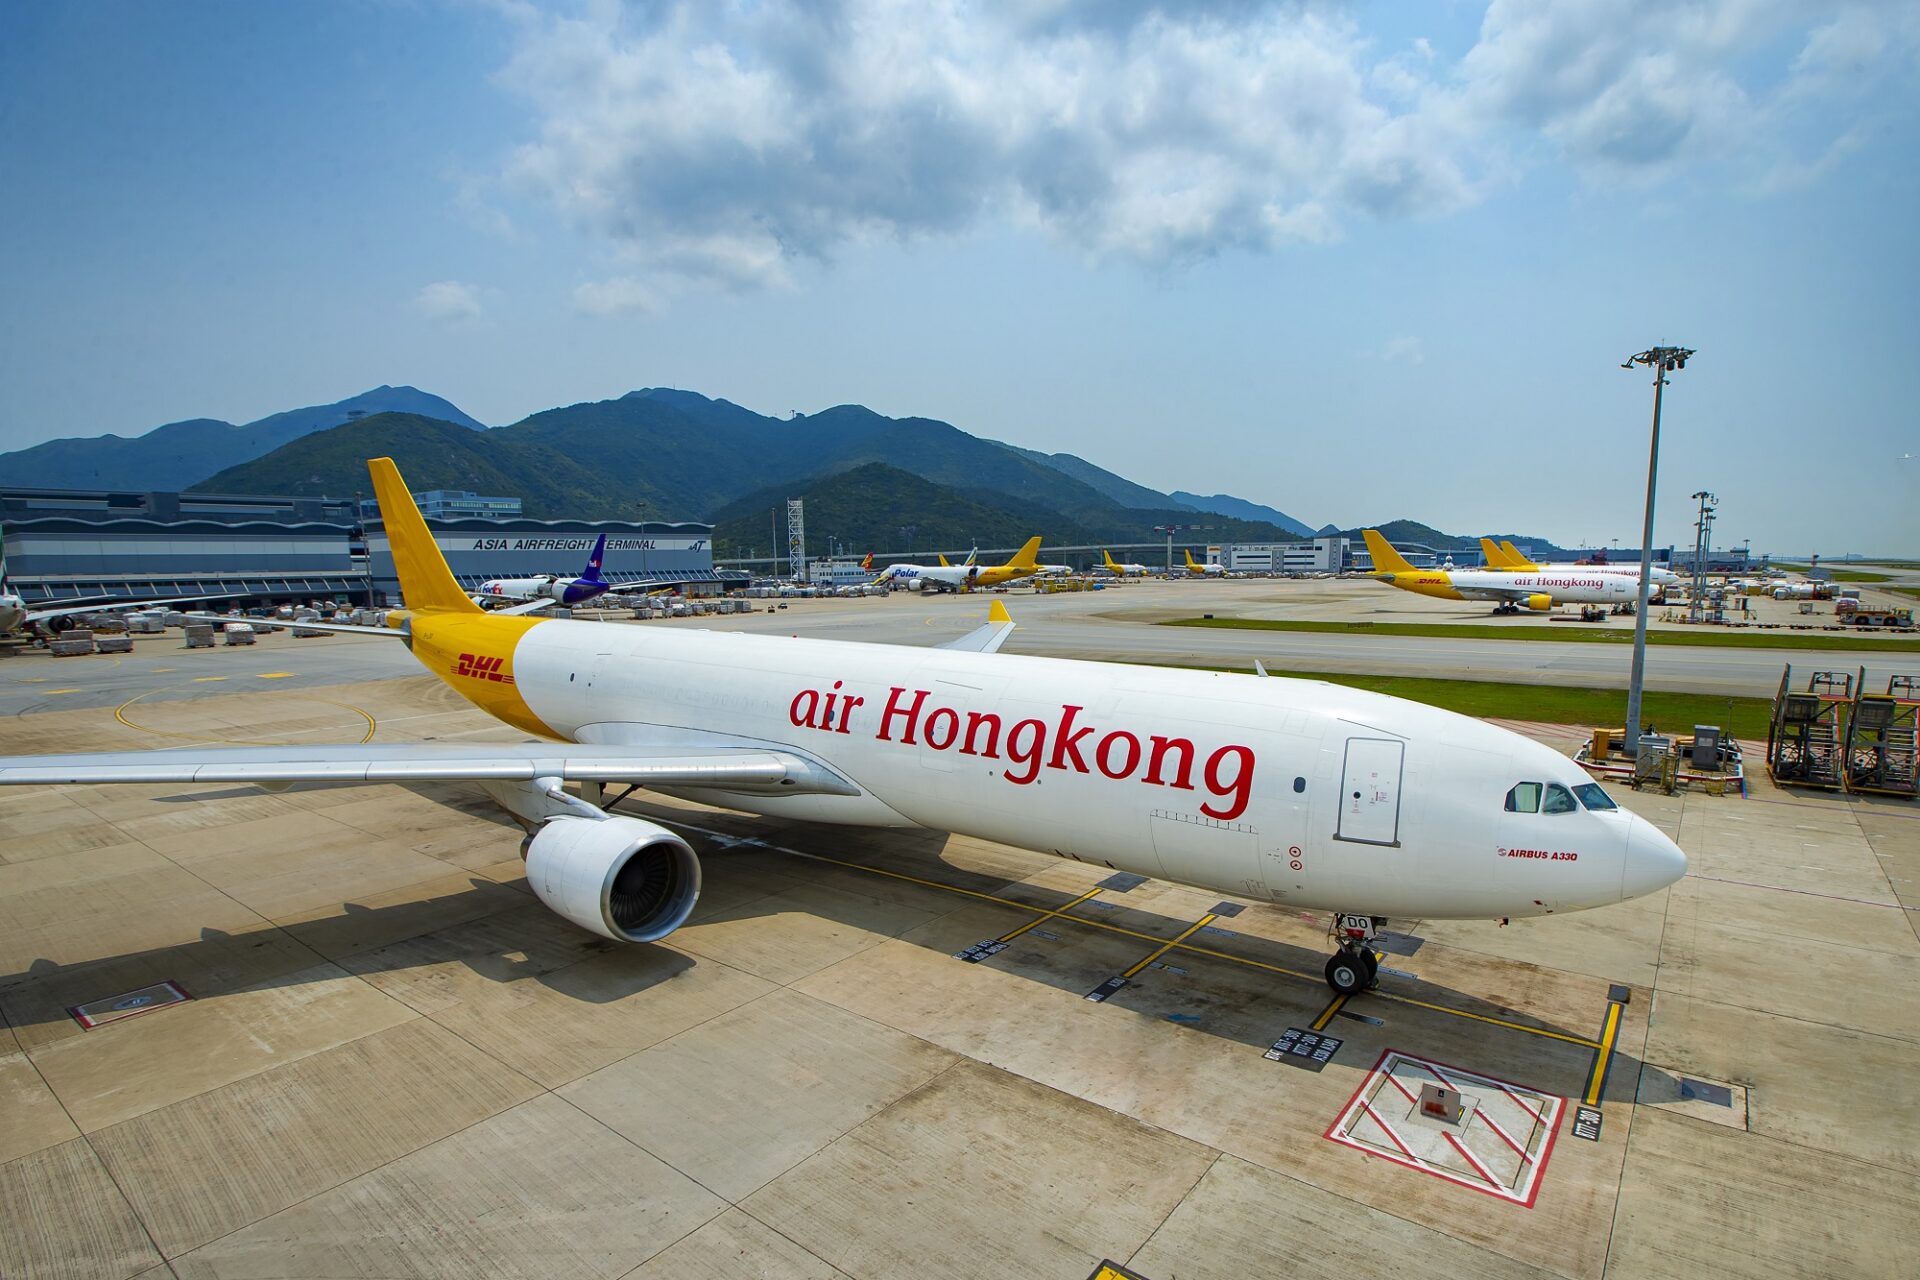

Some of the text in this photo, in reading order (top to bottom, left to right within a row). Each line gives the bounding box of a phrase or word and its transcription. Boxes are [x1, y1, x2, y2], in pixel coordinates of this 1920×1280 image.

[473, 540, 656, 550] ASIA AIRFREIGHT ERMINAL
[894, 568, 919, 578] Polar
[1514, 577, 1604, 589] air Hongkong
[458, 653, 504, 682] DHL
[788, 680, 1256, 821] air Hongkong
[1508, 849, 1578, 861] AIRBUS A330
[1347, 916, 1368, 929] DO
